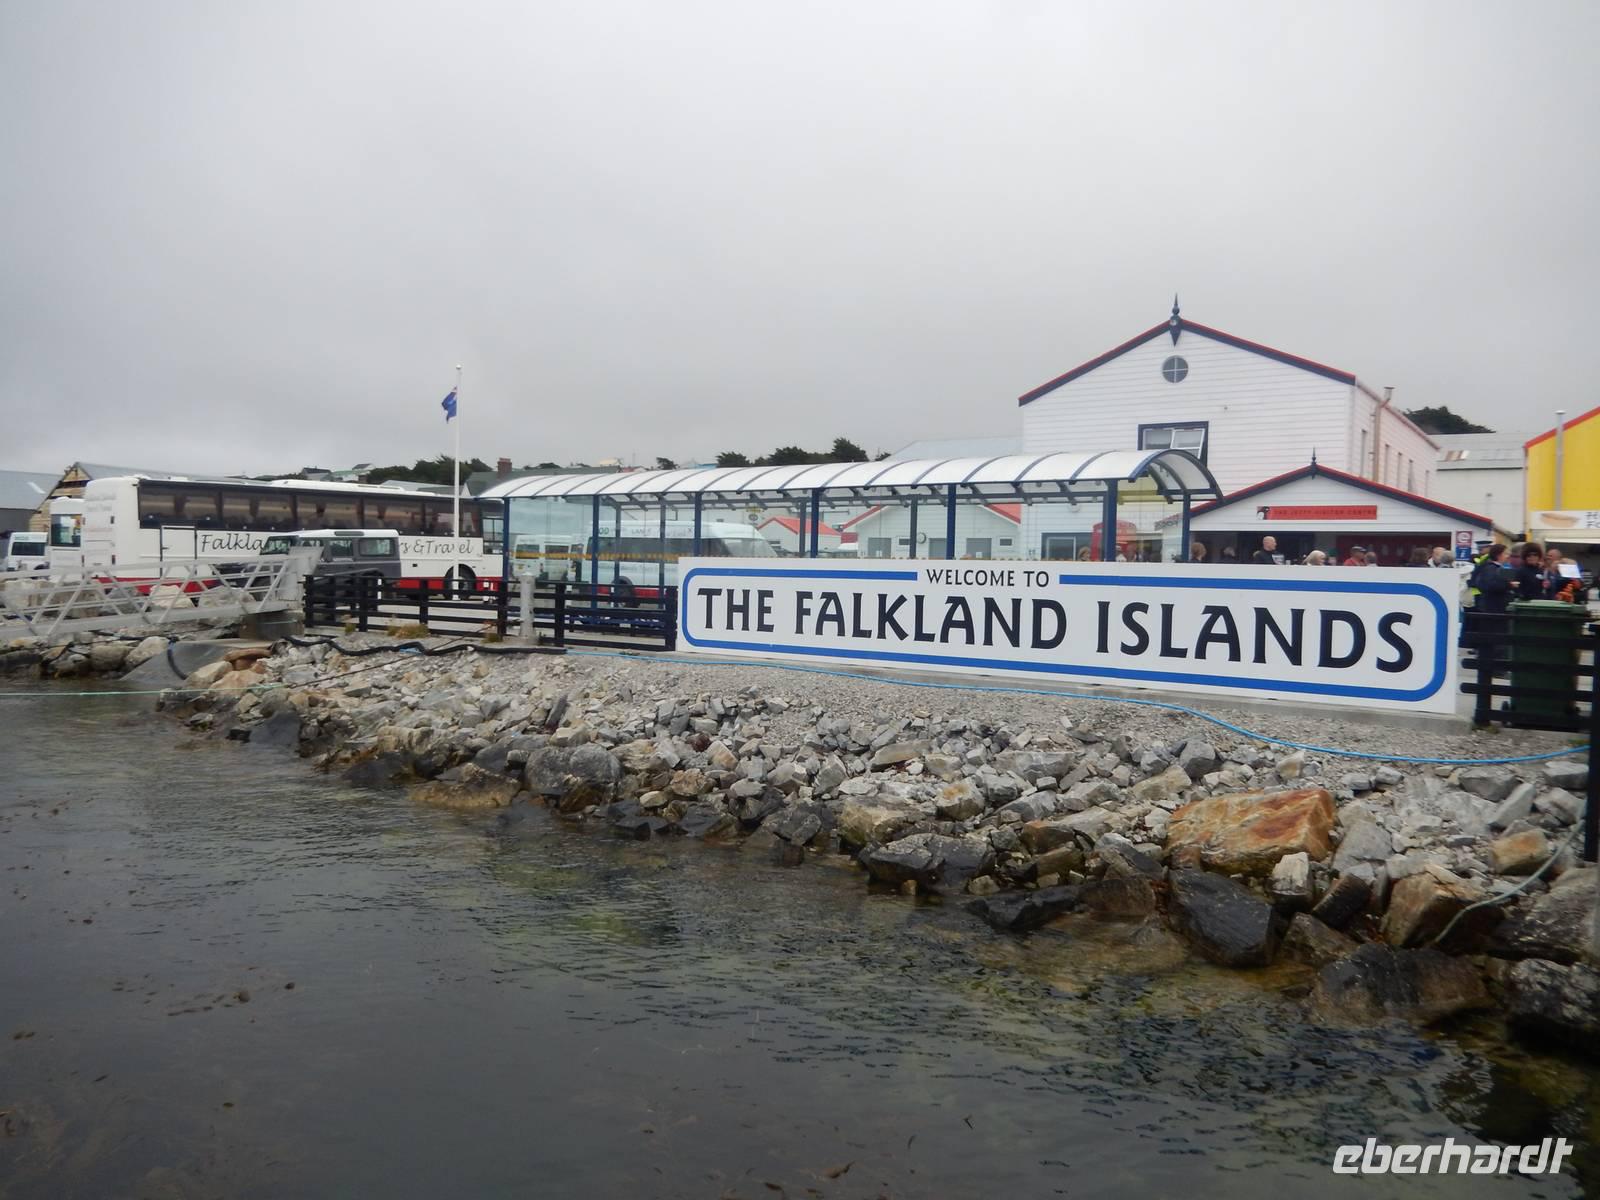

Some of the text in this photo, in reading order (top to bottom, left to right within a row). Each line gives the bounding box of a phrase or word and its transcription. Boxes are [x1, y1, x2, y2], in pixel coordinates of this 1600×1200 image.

[201, 532, 265, 552] Falkla
[927, 569, 1049, 587] WELCOME TO
[698, 588, 1413, 673] THE FALKLAND ISLANDS
